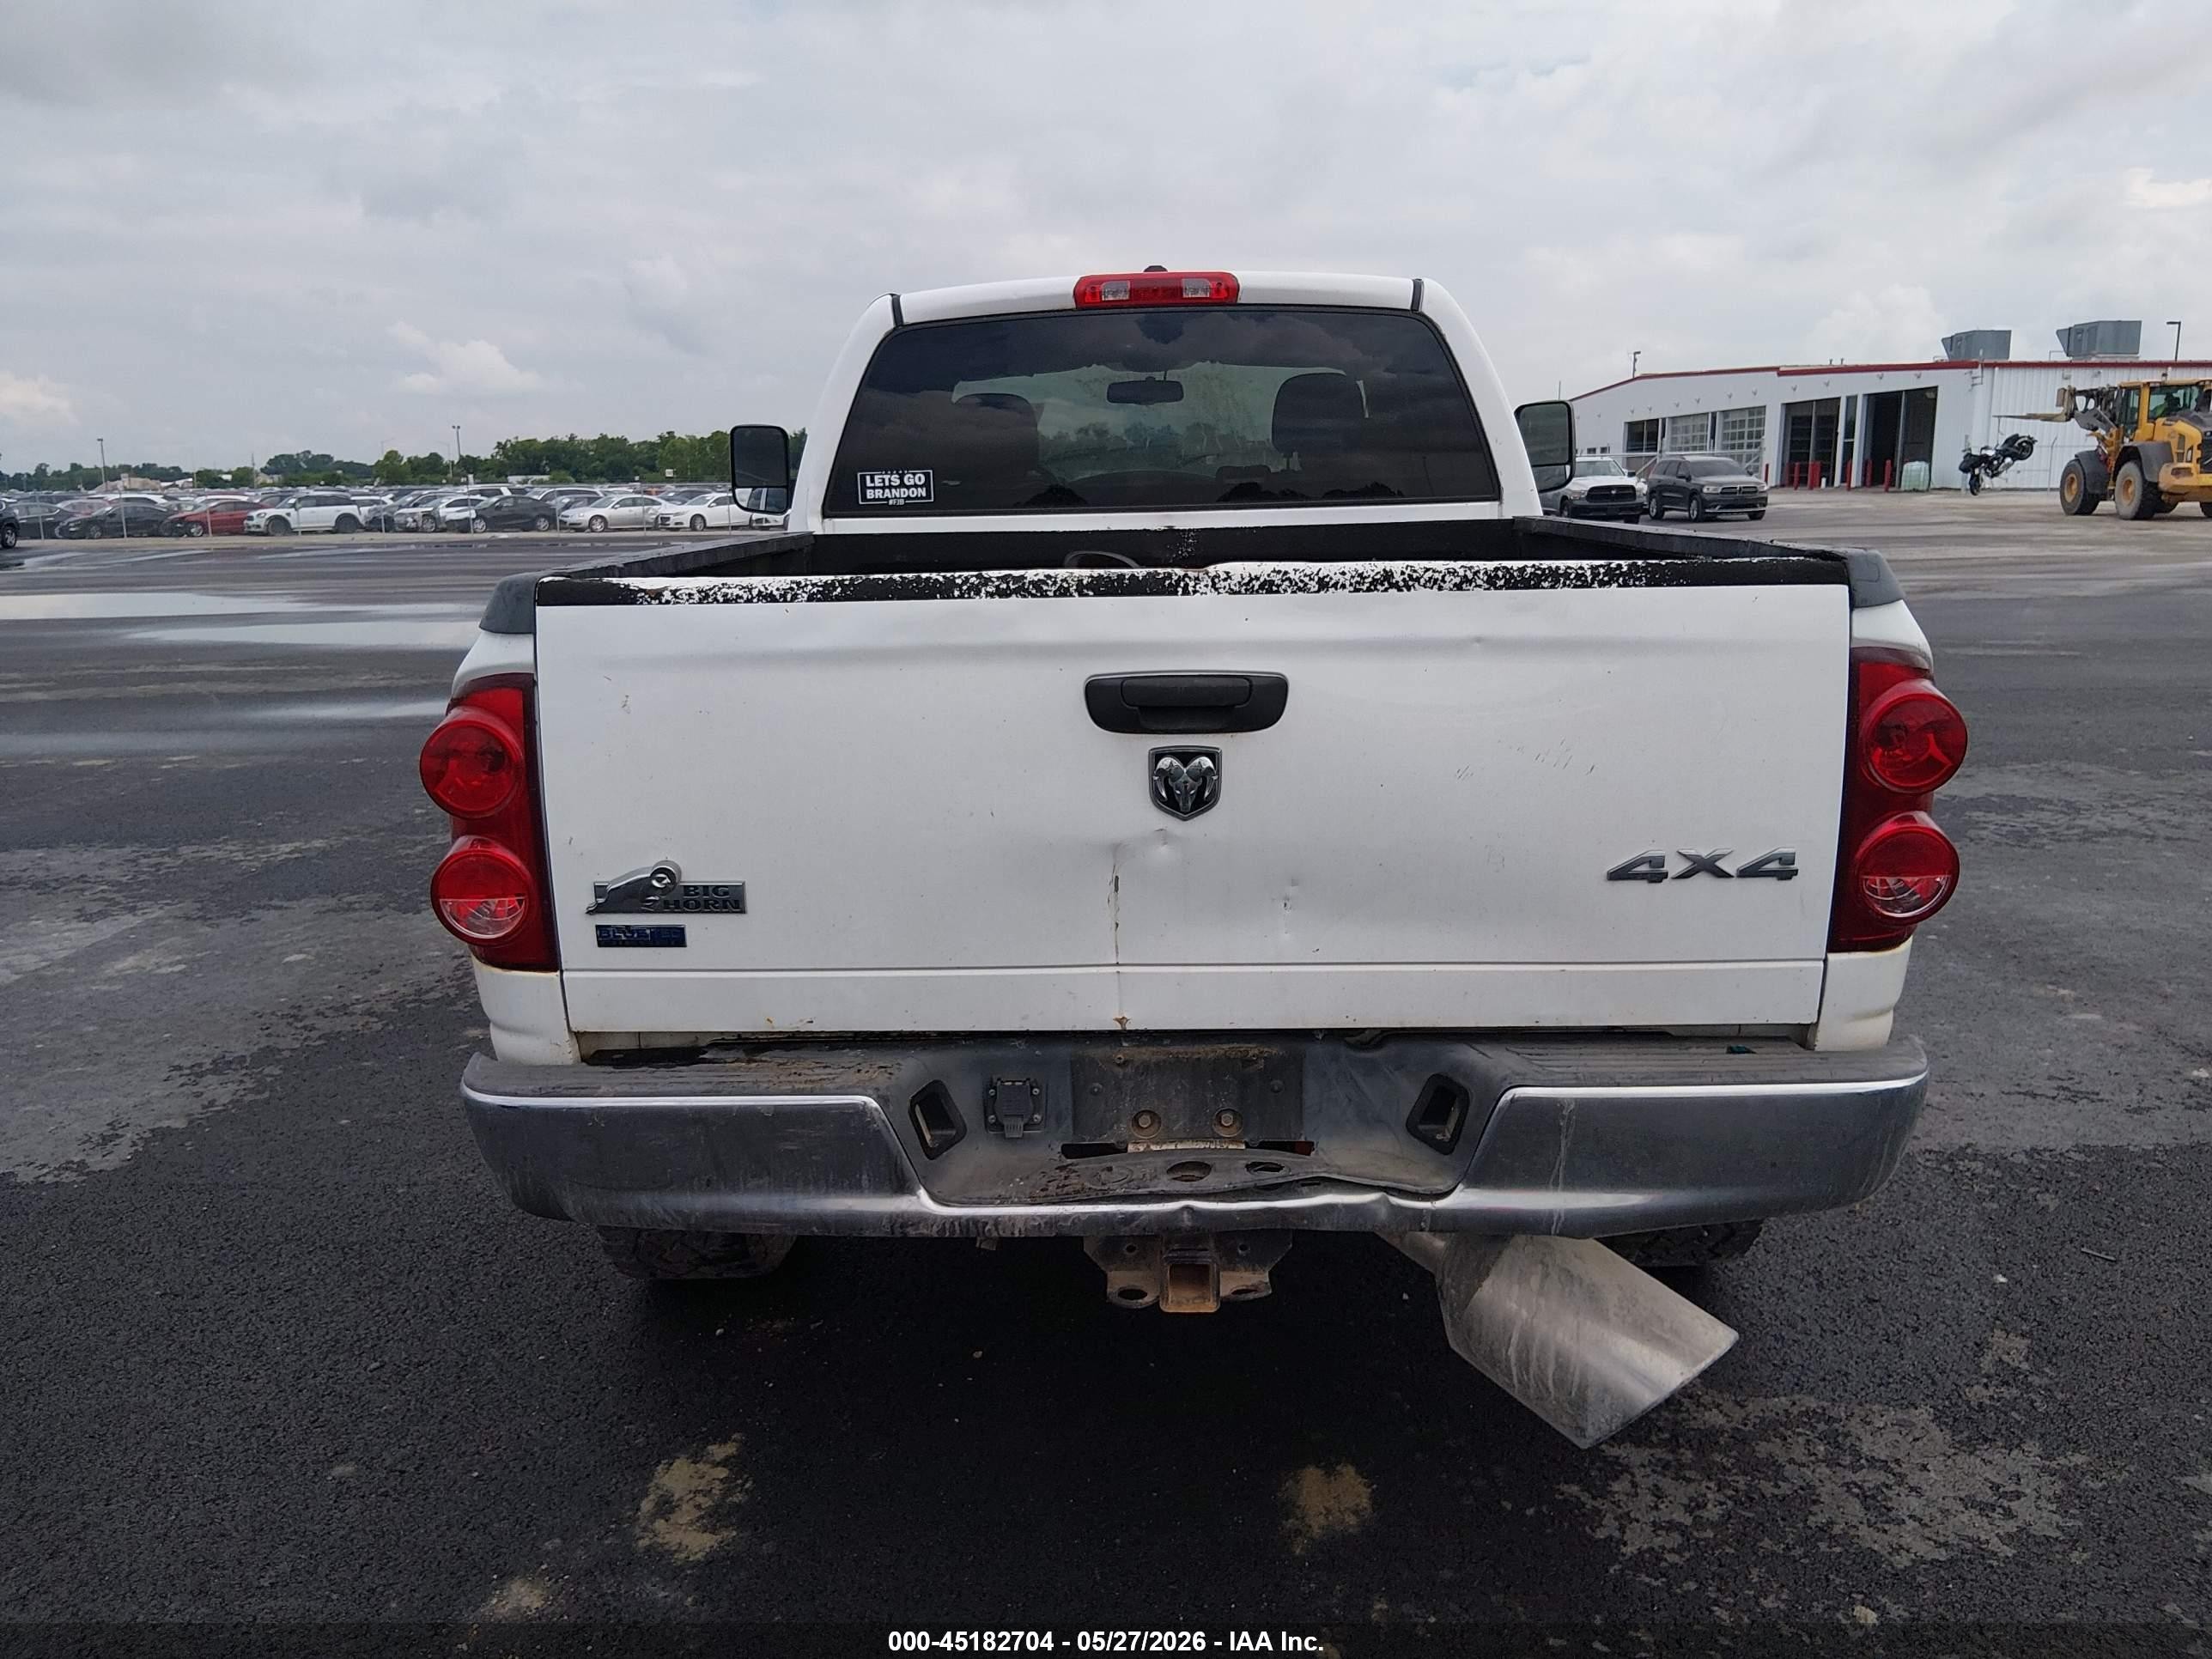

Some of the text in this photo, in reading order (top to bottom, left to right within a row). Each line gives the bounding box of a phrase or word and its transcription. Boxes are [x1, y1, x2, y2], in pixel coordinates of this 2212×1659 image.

[866, 473, 926, 487] LETS GO
[866, 488, 927, 499] BRANDON
[684, 886, 730, 898] BIG
[664, 899, 741, 911] HORN
